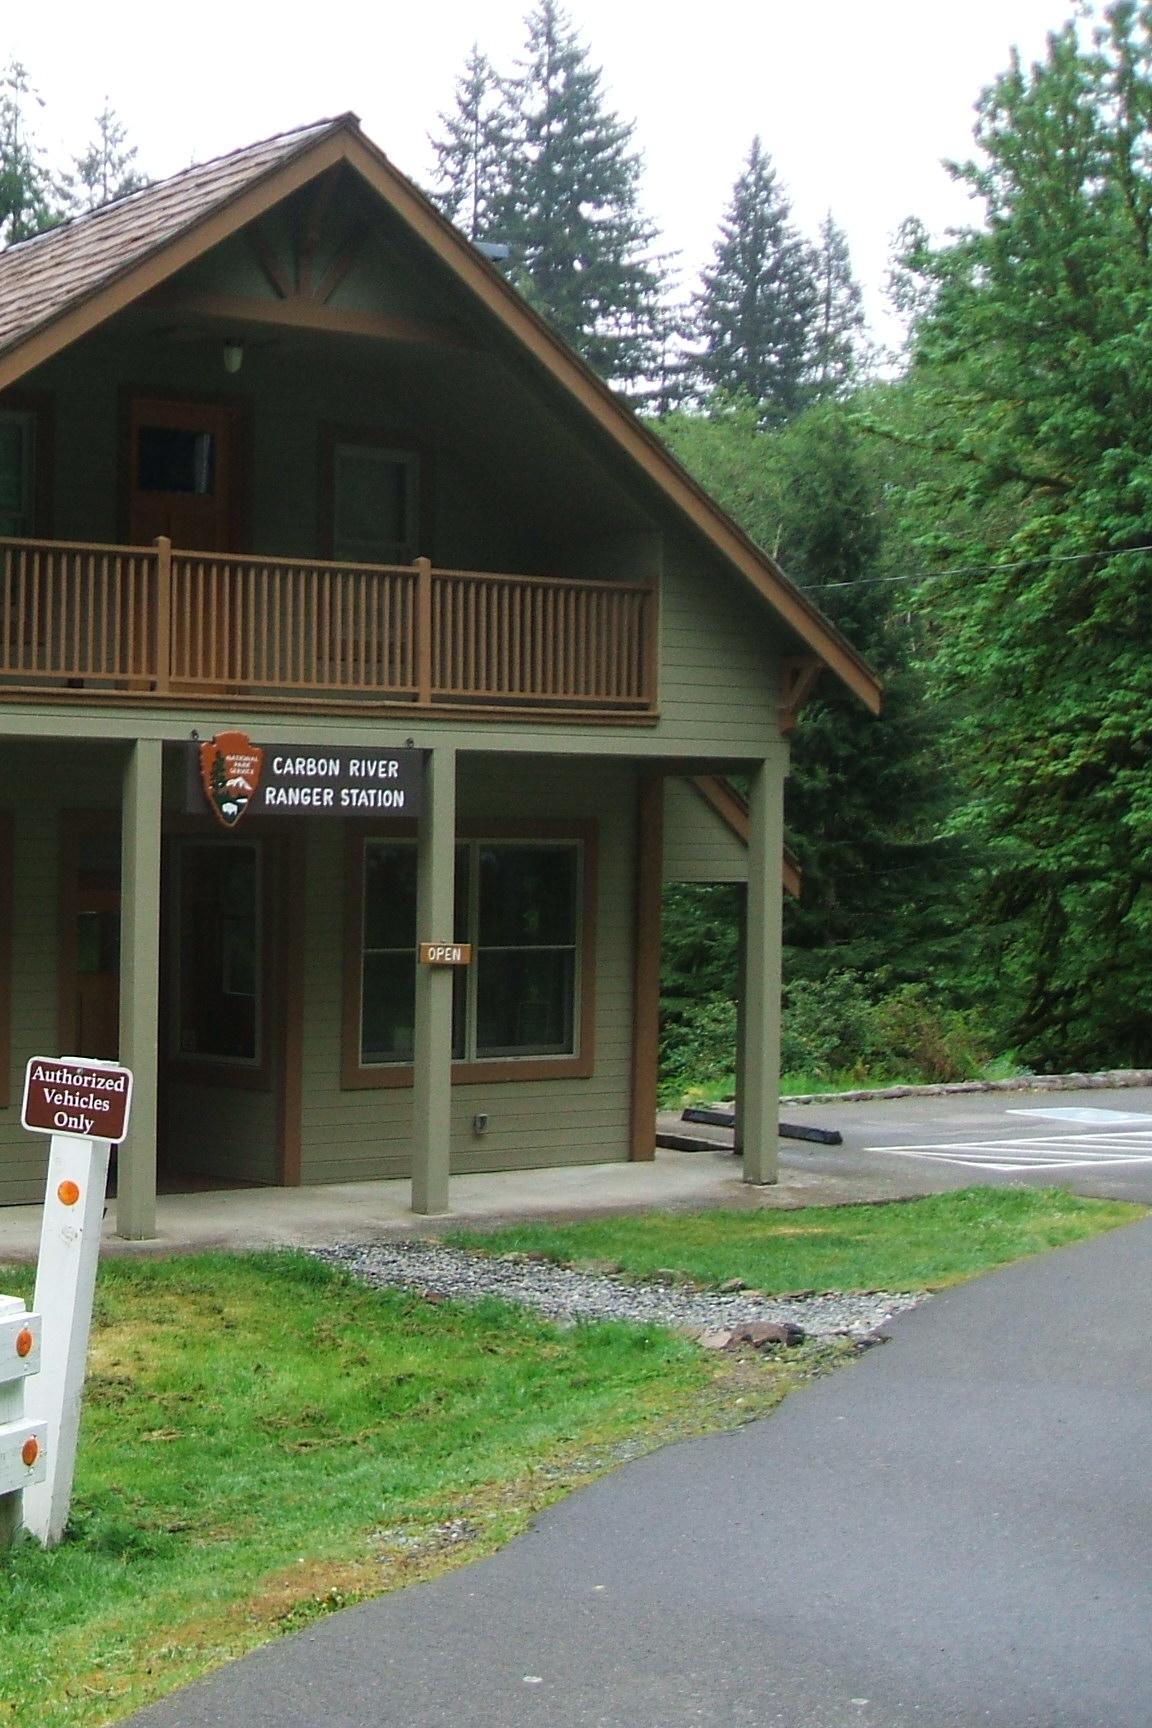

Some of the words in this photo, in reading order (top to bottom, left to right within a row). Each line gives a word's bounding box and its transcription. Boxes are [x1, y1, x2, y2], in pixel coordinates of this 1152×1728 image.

[273, 757, 340, 776] CARBON
[349, 759, 399, 778] RIVER
[265, 786, 334, 806] RANGER
[340, 788, 404, 808] STATION
[428, 947, 461, 961] OPEN
[32, 1066, 125, 1092] Authorized
[43, 1088, 110, 1111] Vehicles
[54, 1111, 95, 1134] Only
